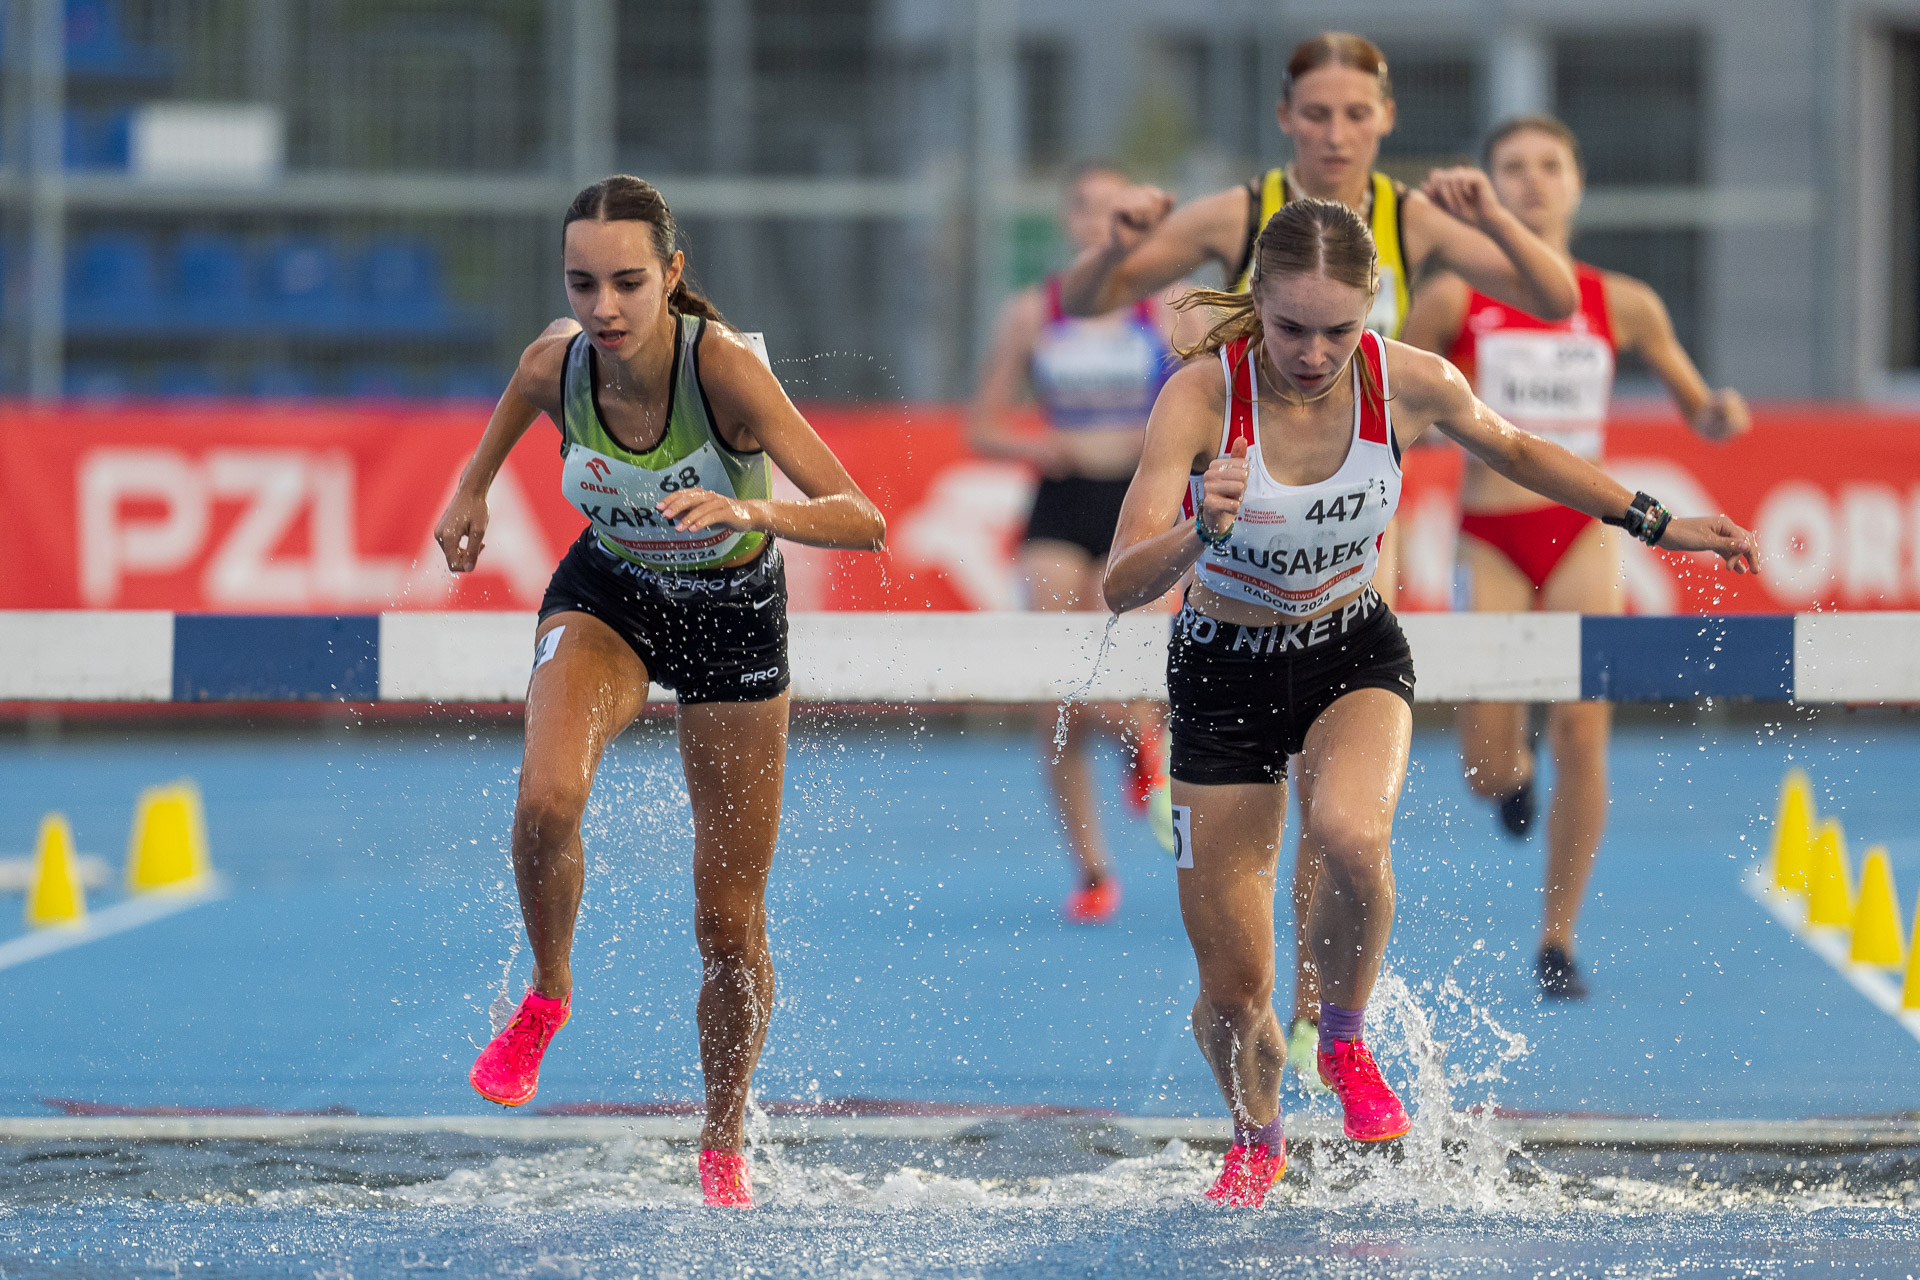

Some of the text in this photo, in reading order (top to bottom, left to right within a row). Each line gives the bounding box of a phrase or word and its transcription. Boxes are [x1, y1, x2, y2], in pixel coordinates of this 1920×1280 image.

[580, 481, 619, 496] ORLEN
[660, 466, 700, 493] 68
[1305, 492, 1366, 525] 447
[77, 444, 562, 608] PZLA
[680, 549, 717, 560] 2024
[1754, 480, 1920, 607] OR
[674, 579, 726, 592] PRO
[1243, 585, 1331, 613] RADOM 2024
[1259, 580, 1314, 600] Mistrzostwa
[1314, 577, 1336, 596] Polski
[1232, 611, 1333, 654] NIKE
[740, 667, 779, 684] PRO
